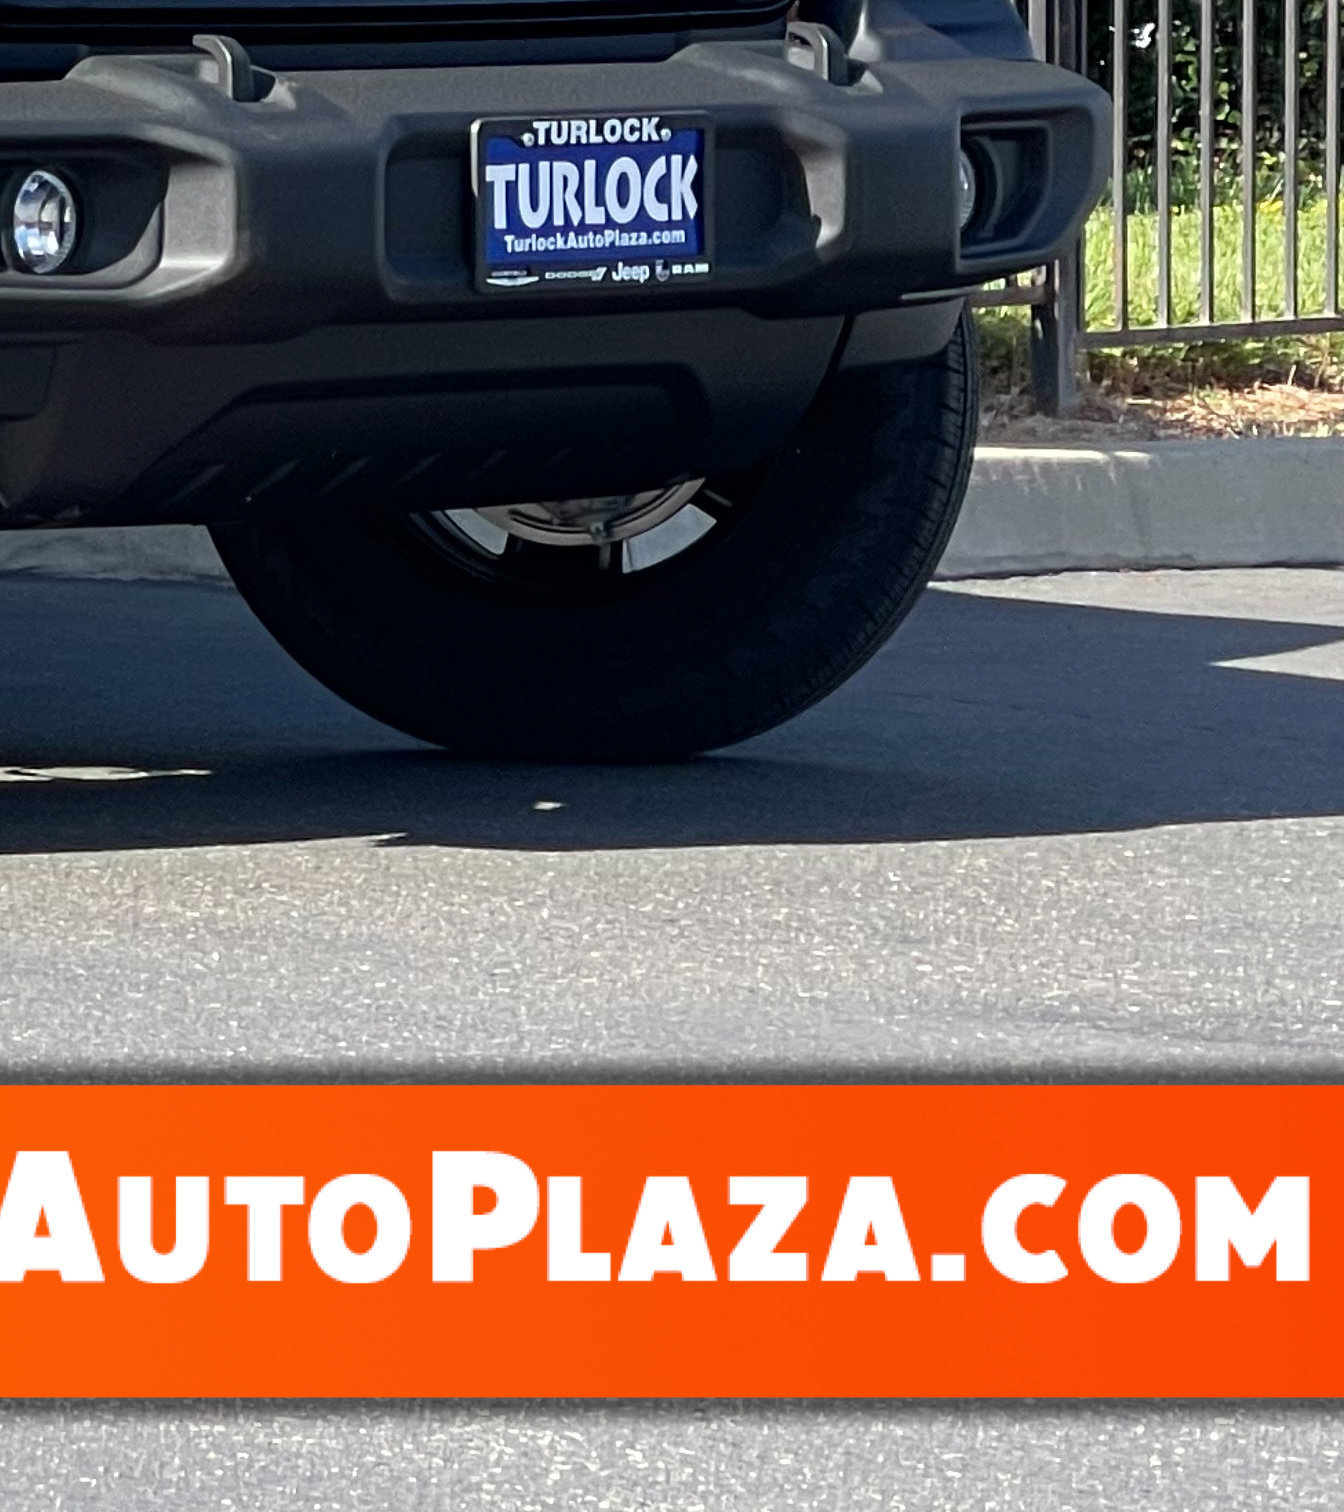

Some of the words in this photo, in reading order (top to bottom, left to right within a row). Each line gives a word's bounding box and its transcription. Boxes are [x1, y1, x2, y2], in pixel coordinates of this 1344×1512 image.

[532, 116, 661, 146] TURLOCK
[485, 153, 699, 230] TURLOCK
[504, 230, 686, 254] TurlockAutoPlaza.com
[611, 261, 650, 283] Jeep
[672, 262, 710, 275] RAM
